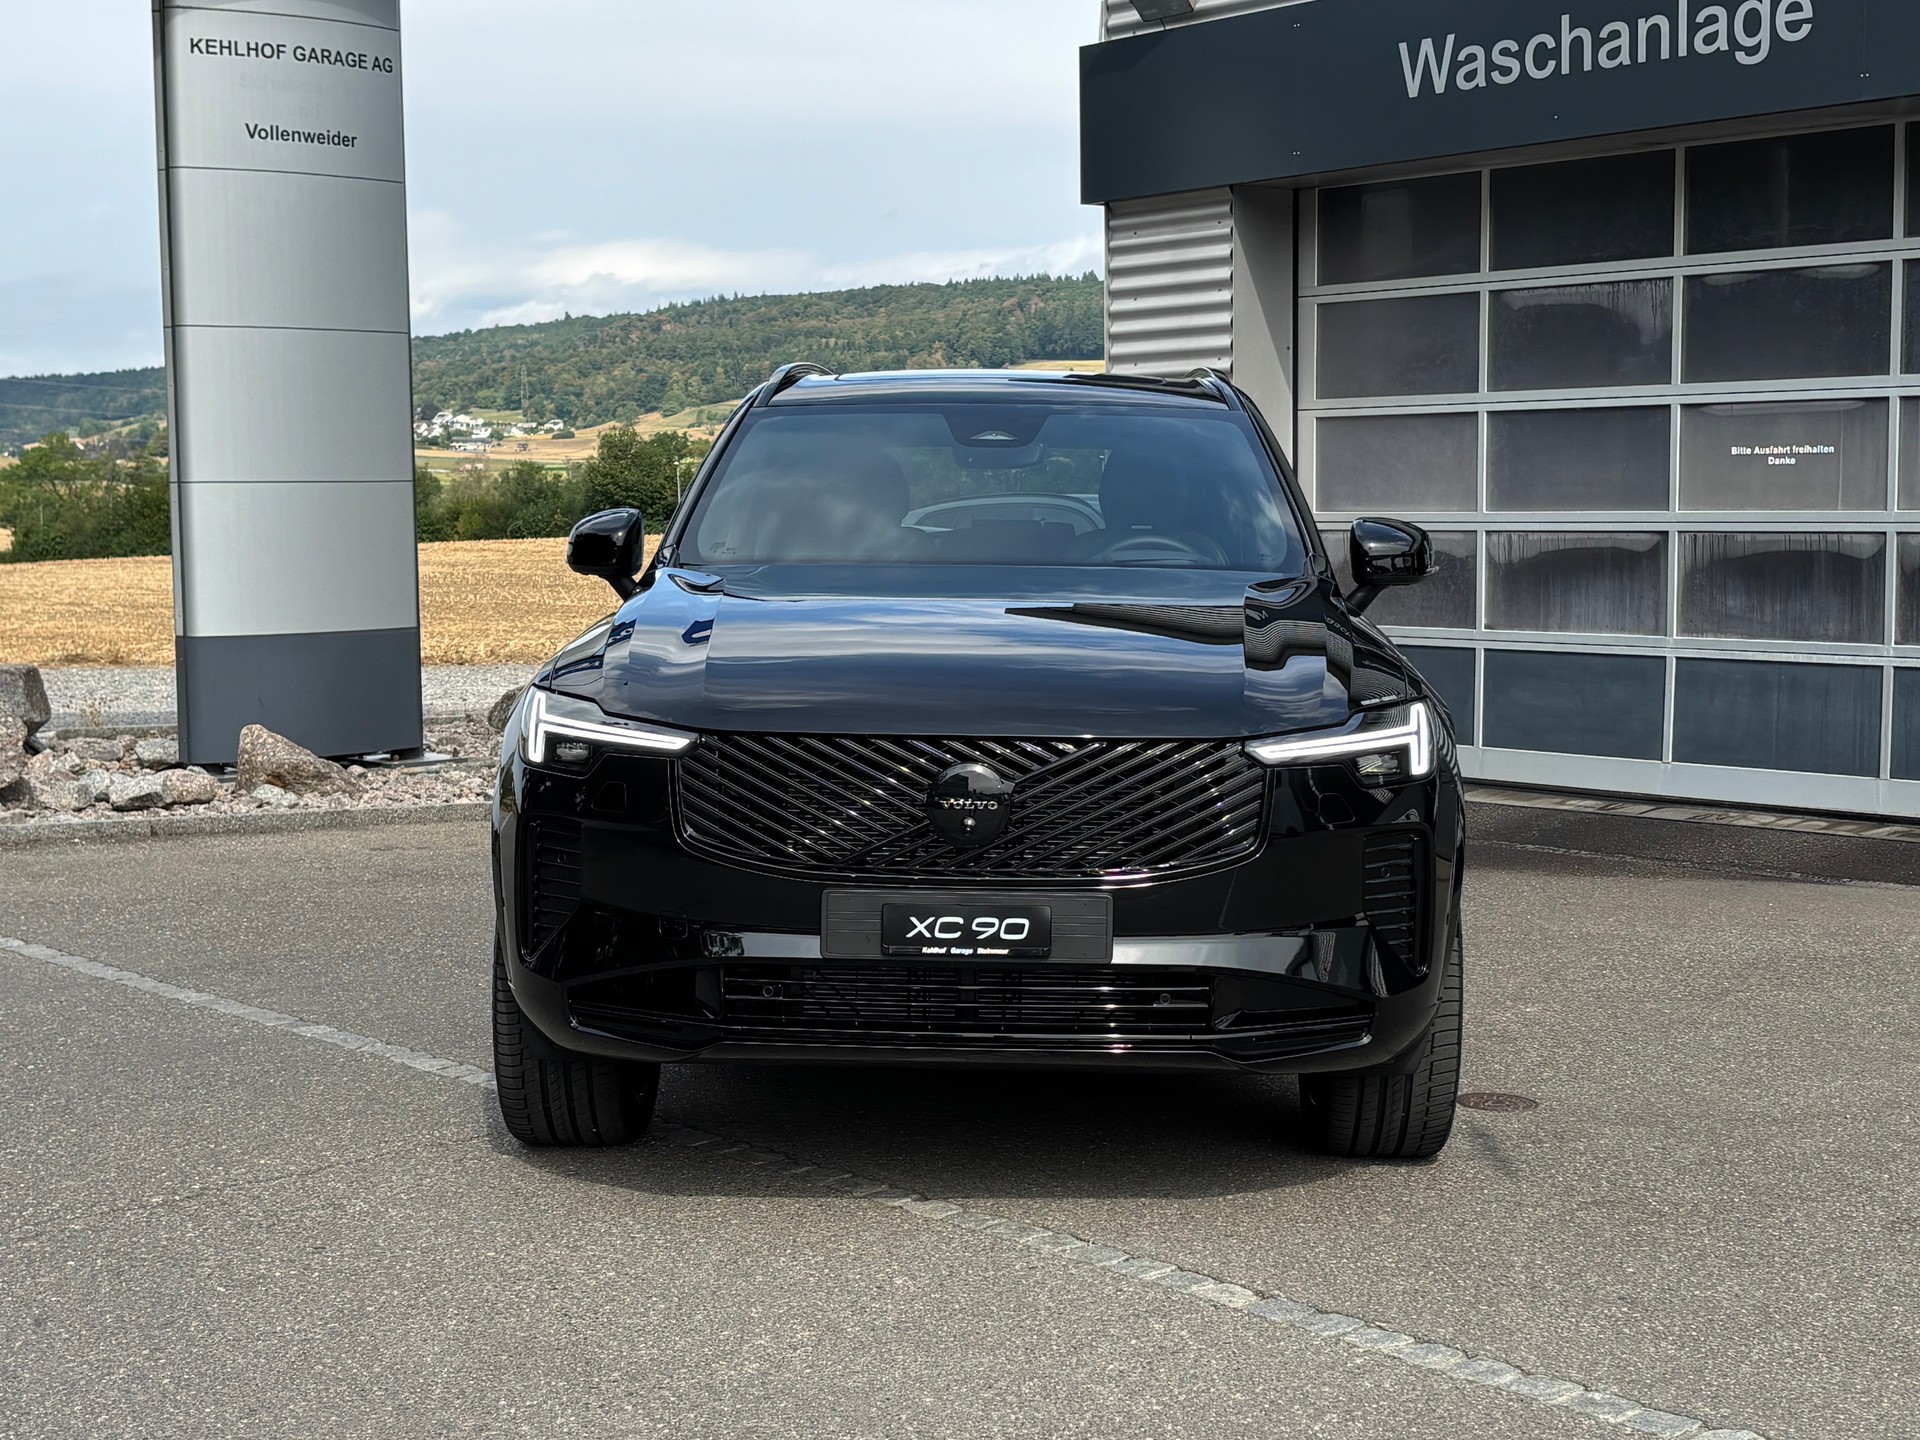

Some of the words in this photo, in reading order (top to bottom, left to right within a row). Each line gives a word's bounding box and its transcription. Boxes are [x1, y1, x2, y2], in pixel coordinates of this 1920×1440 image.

[190, 37, 287, 60] KEHLHOF
[292, 45, 369, 70] GARAGE
[371, 55, 394, 74] AG
[1398, 0, 1814, 98] Waschanlage
[245, 122, 358, 148] Vollenweider
[1731, 446, 1752, 455] Bitte
[1754, 445, 1791, 455] Ausfahrt
[1792, 444, 1835, 454] freihalten
[1767, 456, 1796, 466] Danke
[939, 799, 998, 810] VOLVO
[905, 916, 965, 939] XC
[971, 916, 1030, 940] 90
[949, 946, 974, 956] Garage
